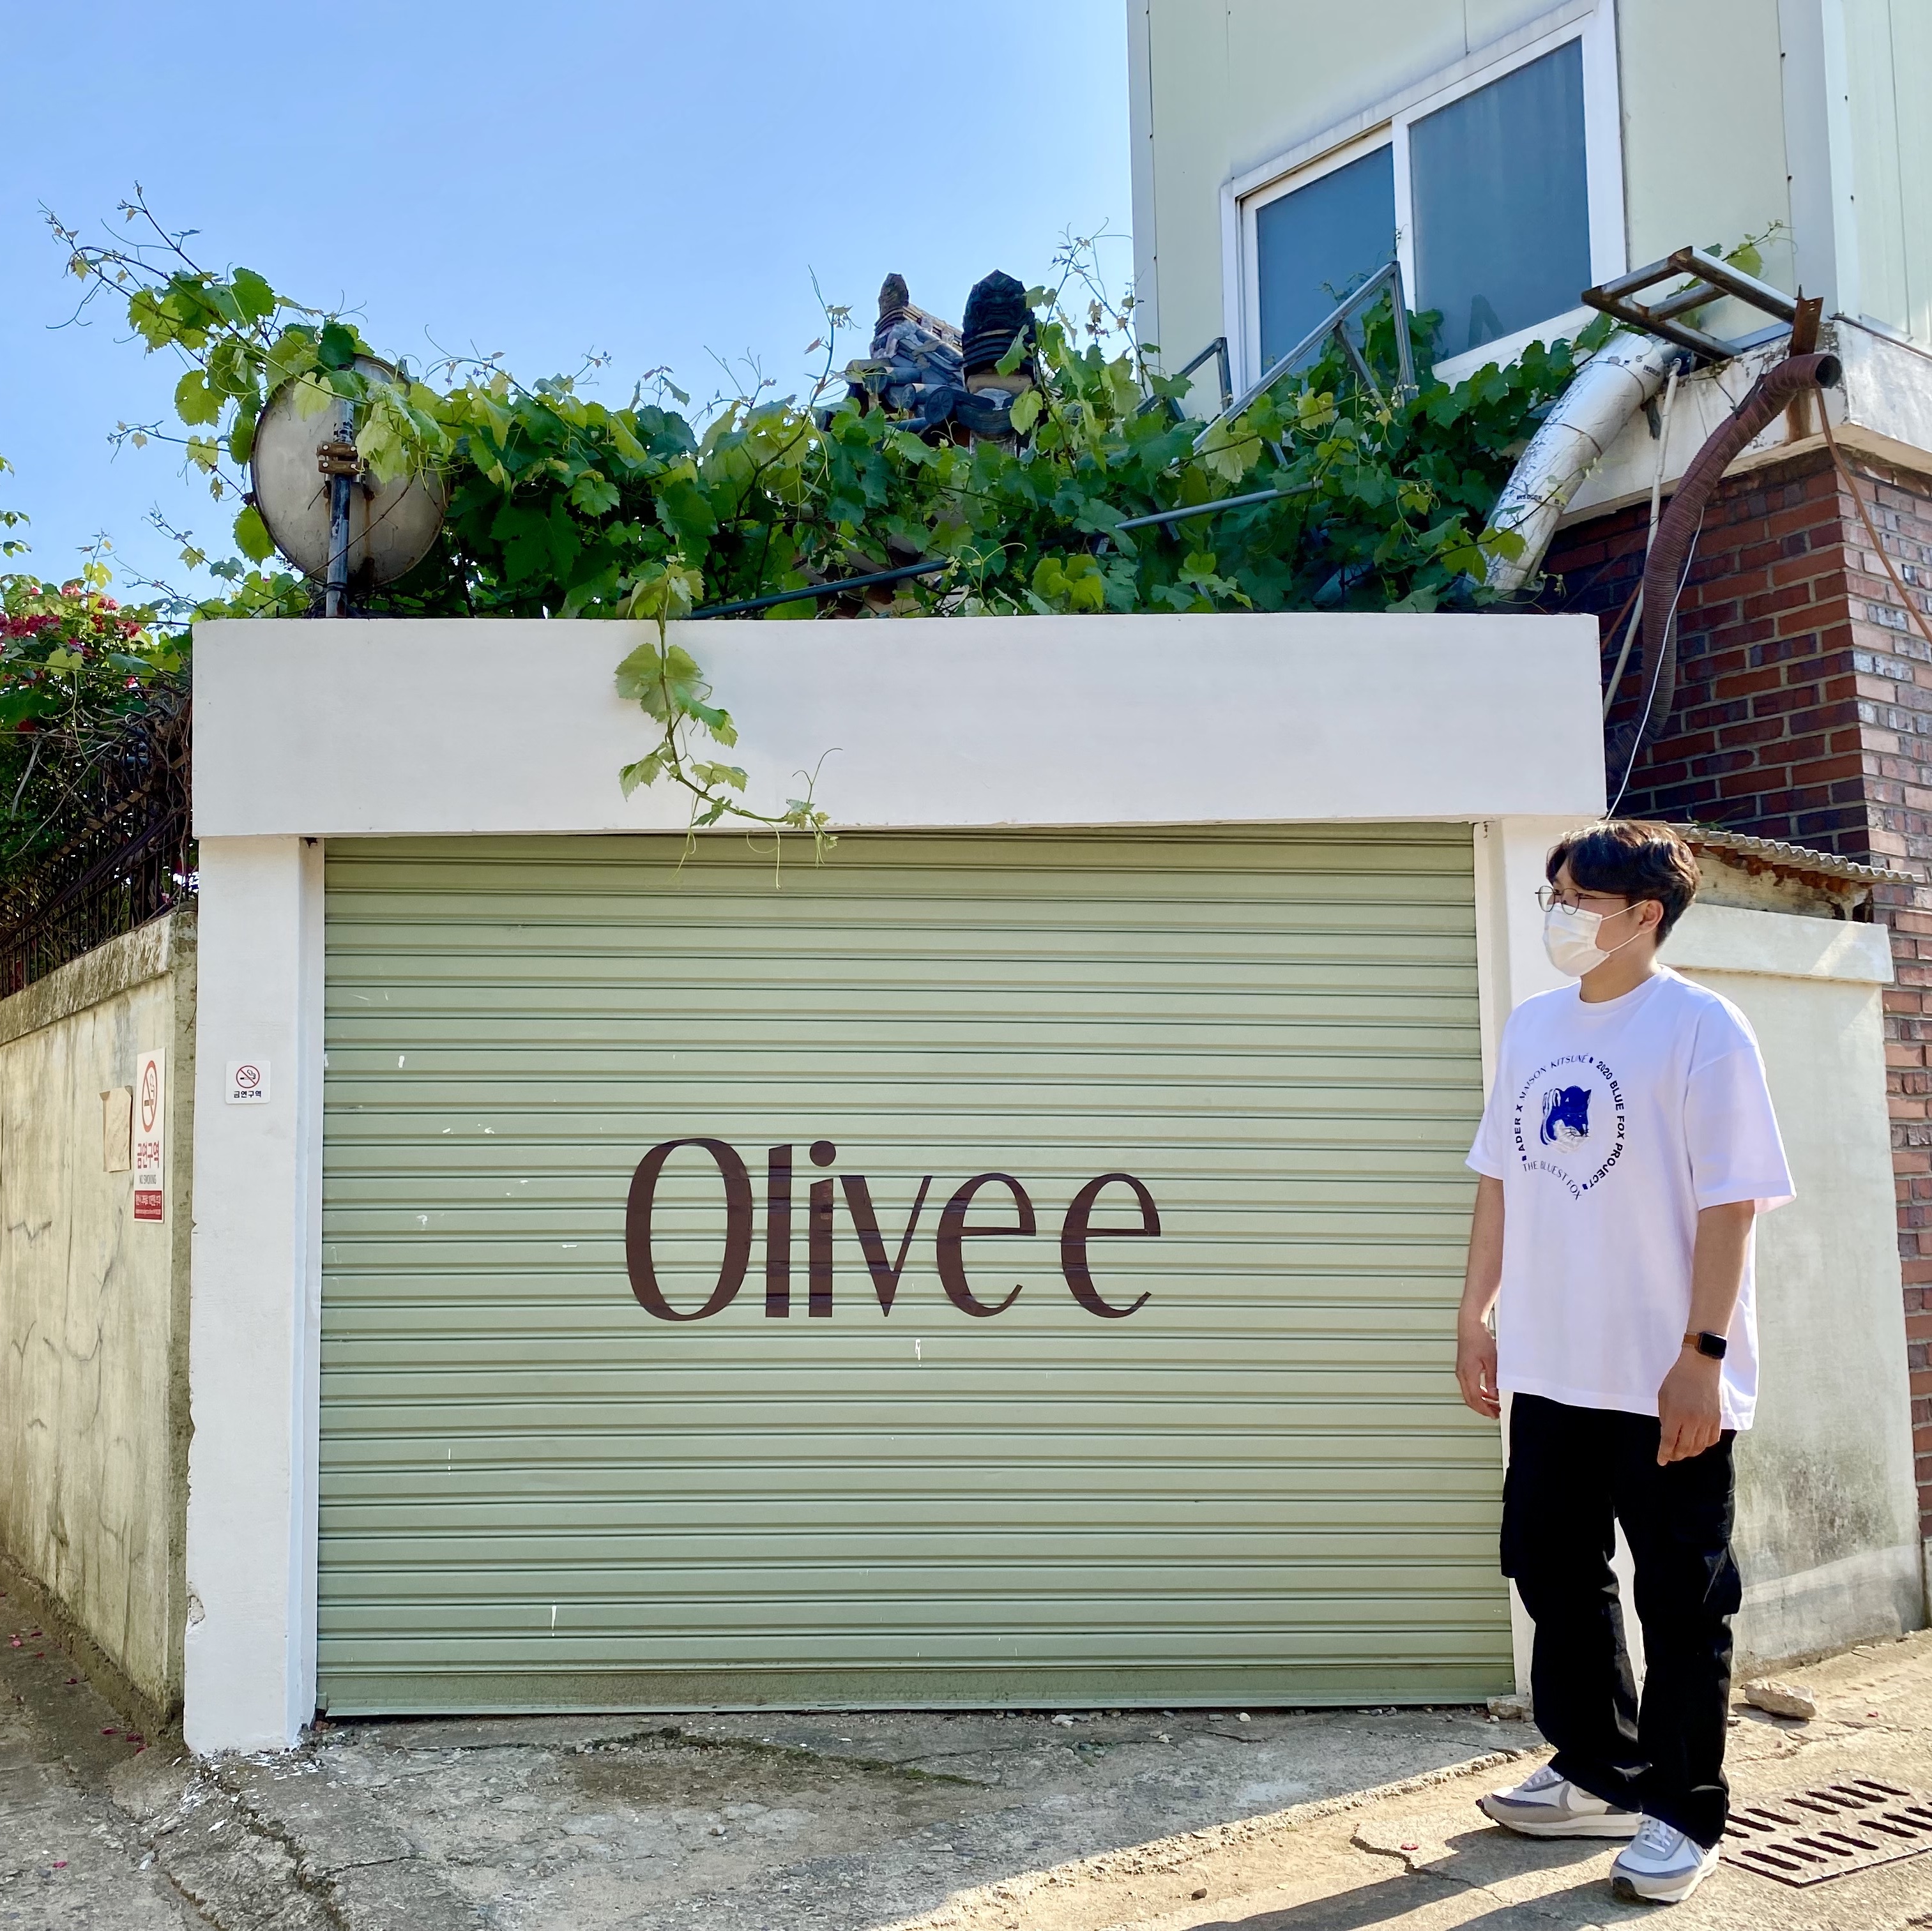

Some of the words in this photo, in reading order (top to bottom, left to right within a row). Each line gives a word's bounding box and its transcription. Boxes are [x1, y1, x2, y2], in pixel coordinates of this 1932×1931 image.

[1519, 1066, 1546, 1101] MAISON
[1596, 1061, 1613, 1080] 2020
[233, 1090, 262, 1098] 금연구역
[1516, 1104, 1523, 1112] X
[1609, 1080, 1624, 1111] BLUE
[1514, 1117, 1526, 1151] ADER
[1616, 1115, 1625, 1140] FOX
[137, 1140, 160, 1169] 금연구역
[1589, 1142, 1624, 1188] PROJECT
[1523, 1160, 1539, 1172] THE
[1540, 1160, 1569, 1181] BLUEST
[1566, 1179, 1582, 1200] FOX
[626, 1138, 1161, 1321] Olivee
